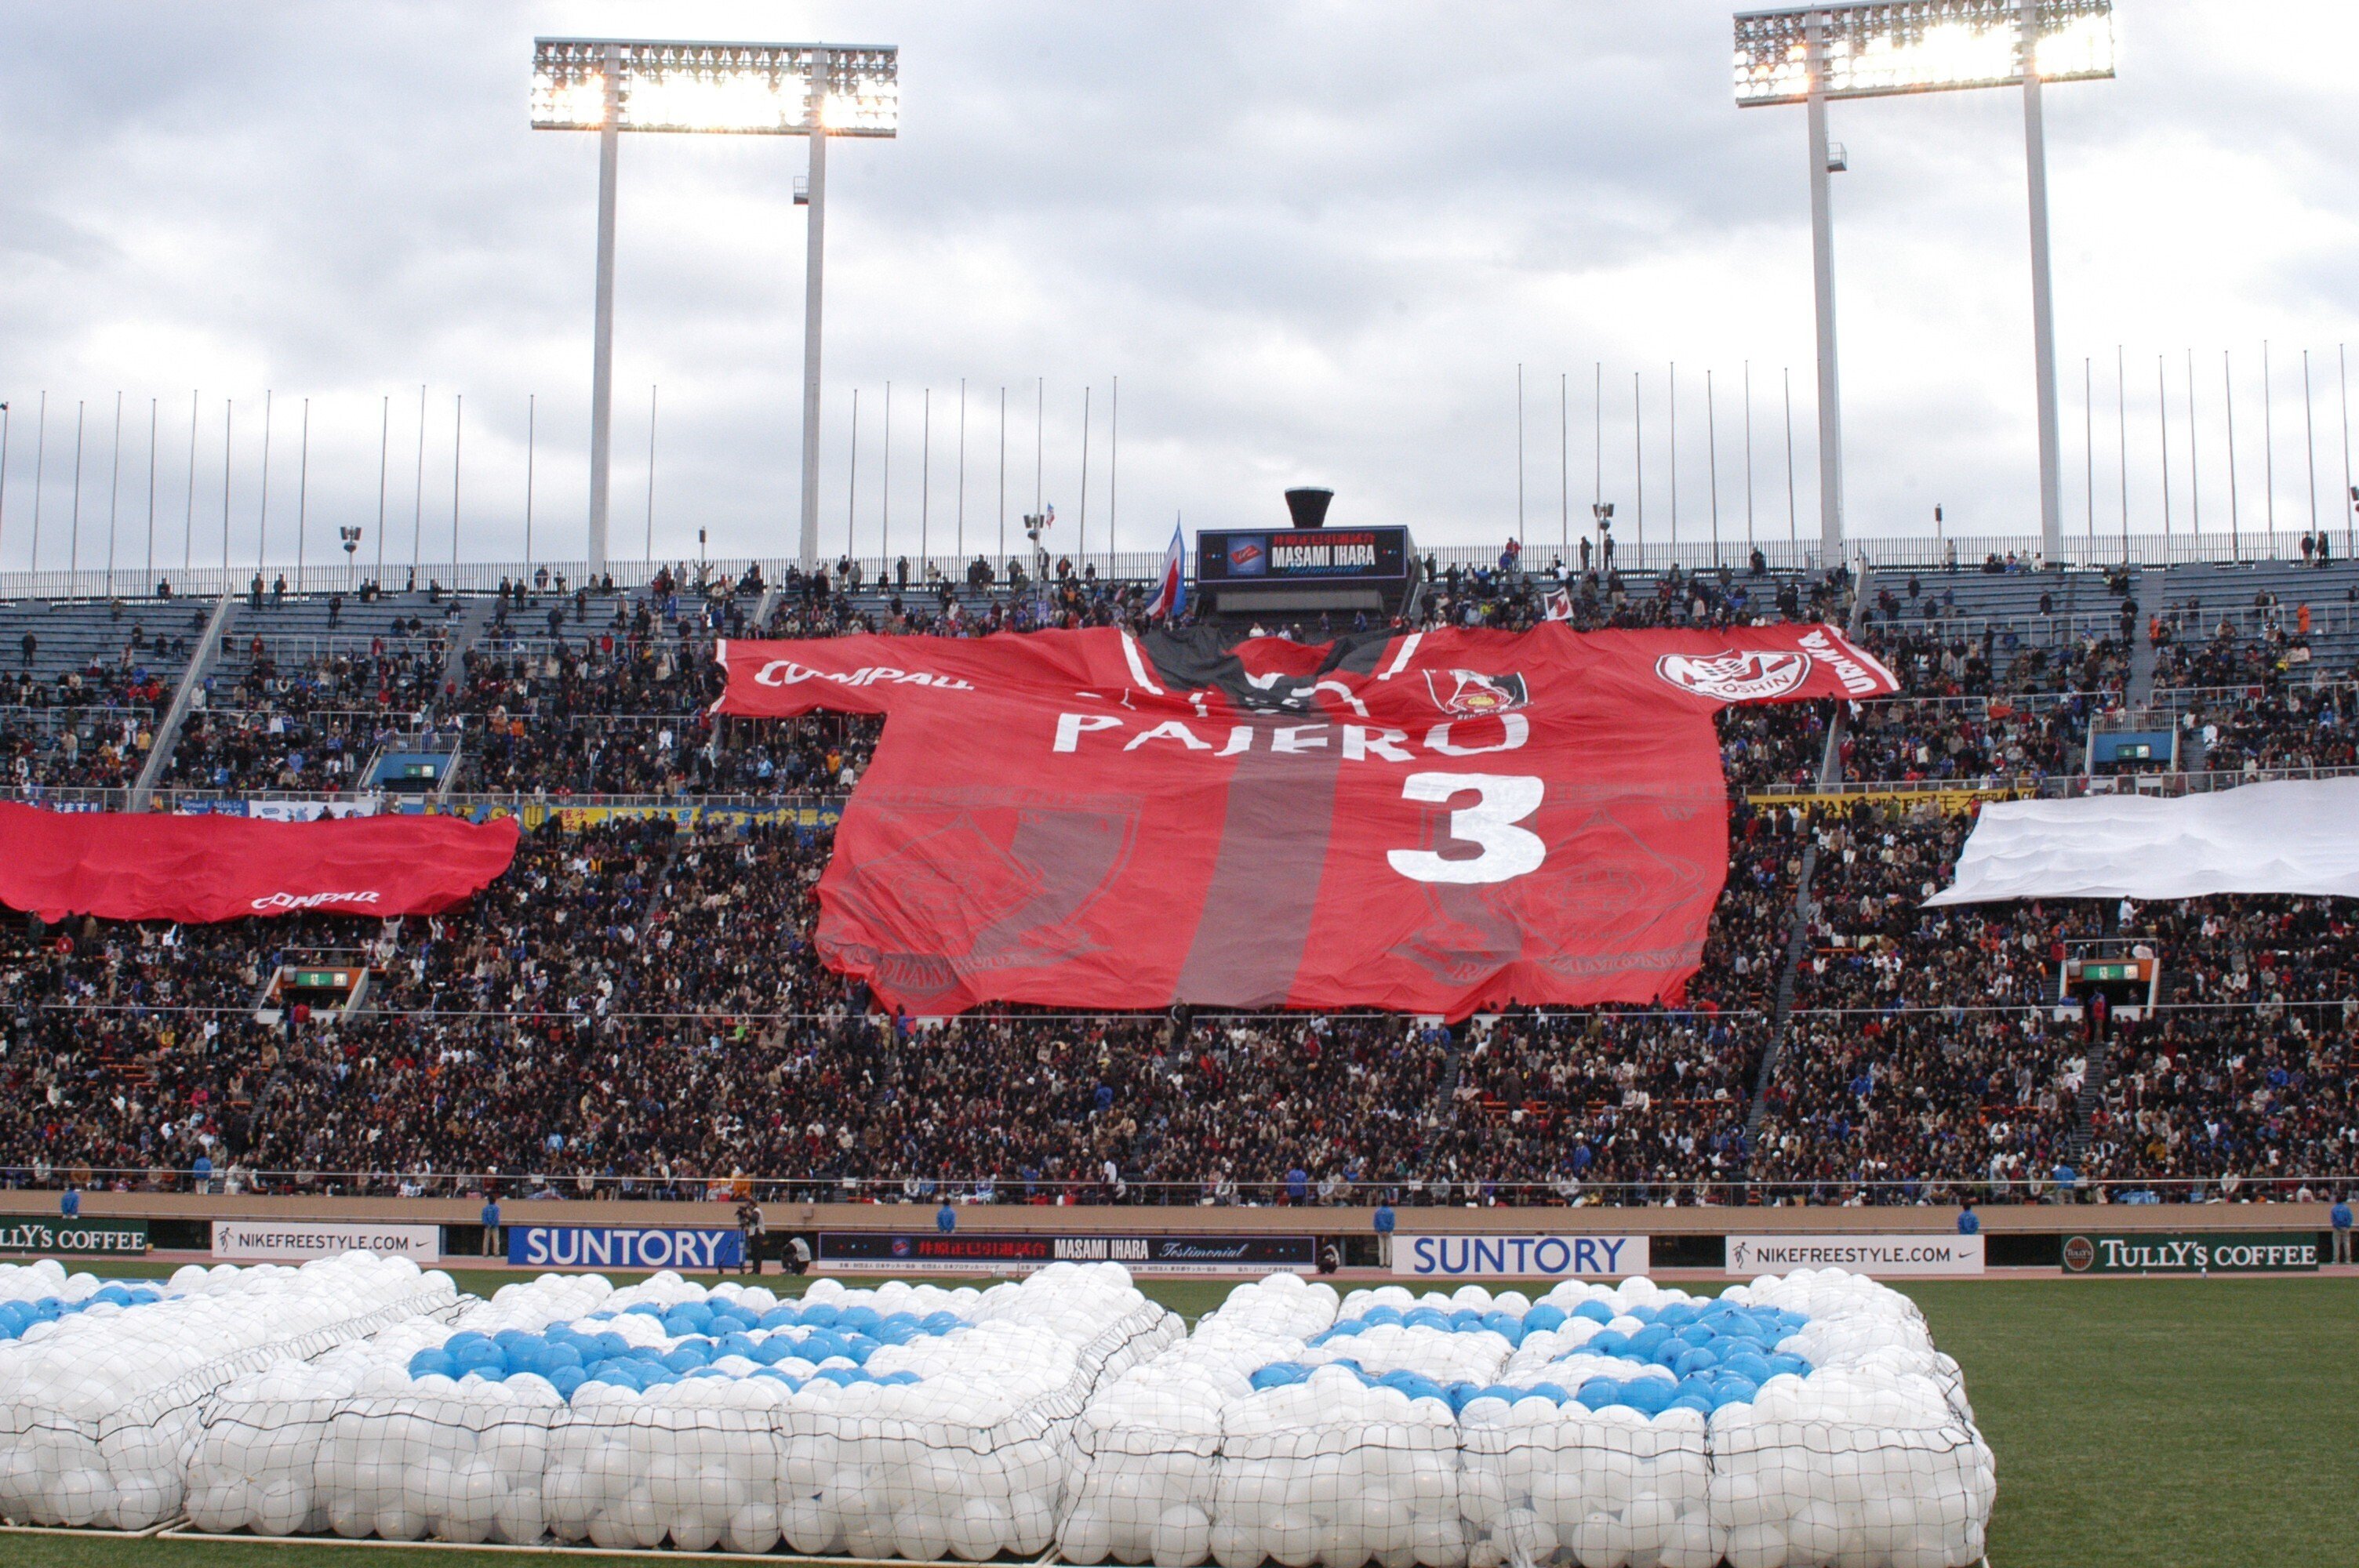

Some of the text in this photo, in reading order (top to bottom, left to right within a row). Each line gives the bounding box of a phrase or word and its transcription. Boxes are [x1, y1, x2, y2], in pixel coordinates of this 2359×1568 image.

[1272, 544, 1376, 568] MASAMI IHARA
[1797, 629, 1877, 694] URAWA
[1052, 712, 1529, 762] PAJERO
[1387, 772, 1547, 884] 3
[251, 891, 380, 909] COMPAQ
[58, 1230, 145, 1250] COFFEE
[239, 1233, 409, 1250] NIKEFREESTYLE.COM
[527, 1228, 725, 1266] SUNTORY
[1055, 1239, 1149, 1260] MASAMI IHARA
[1158, 1242, 1249, 1258] Testimonial
[1414, 1237, 1626, 1273] SUNTORY
[1757, 1247, 1950, 1262] NIKEFREESTYLE.COM
[2214, 1245, 2317, 1266] COFFEE
